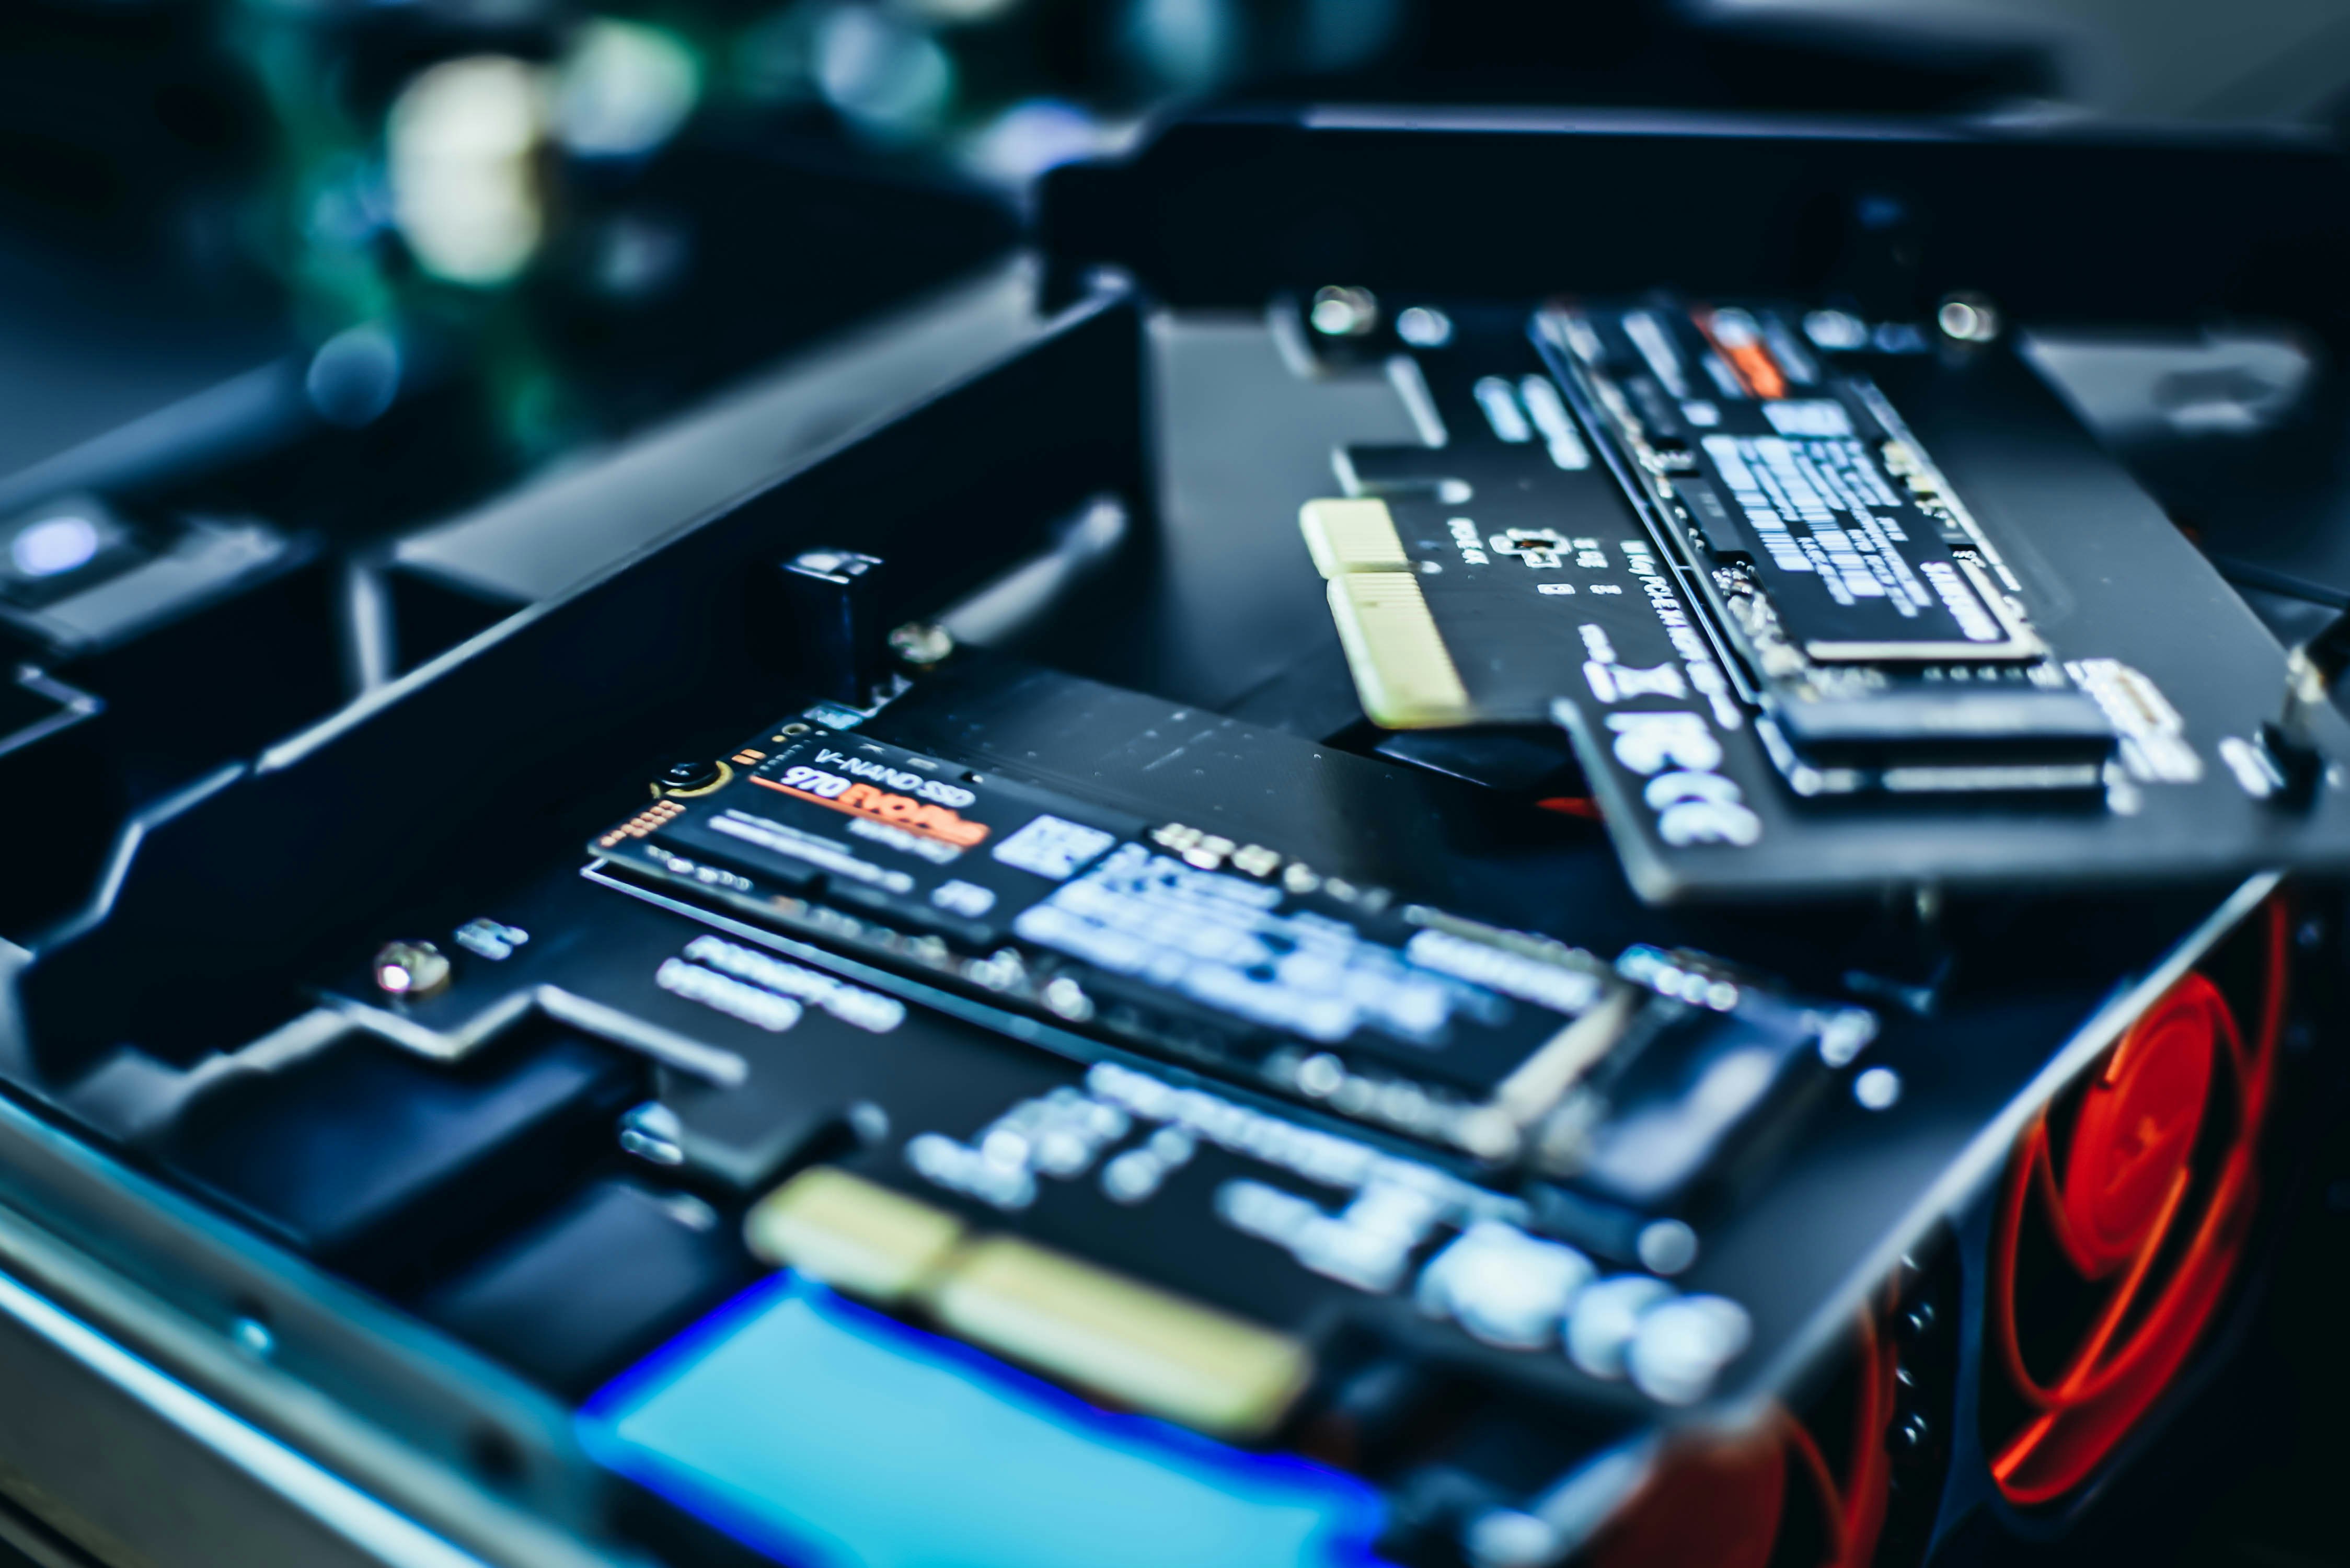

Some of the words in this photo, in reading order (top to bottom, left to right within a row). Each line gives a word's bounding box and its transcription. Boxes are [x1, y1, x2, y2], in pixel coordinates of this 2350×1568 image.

[1639, 576, 1680, 609] PCI-E
[781, 766, 852, 798] 970
[814, 748, 923, 790] V-NAND
[915, 780, 976, 808] SSD
